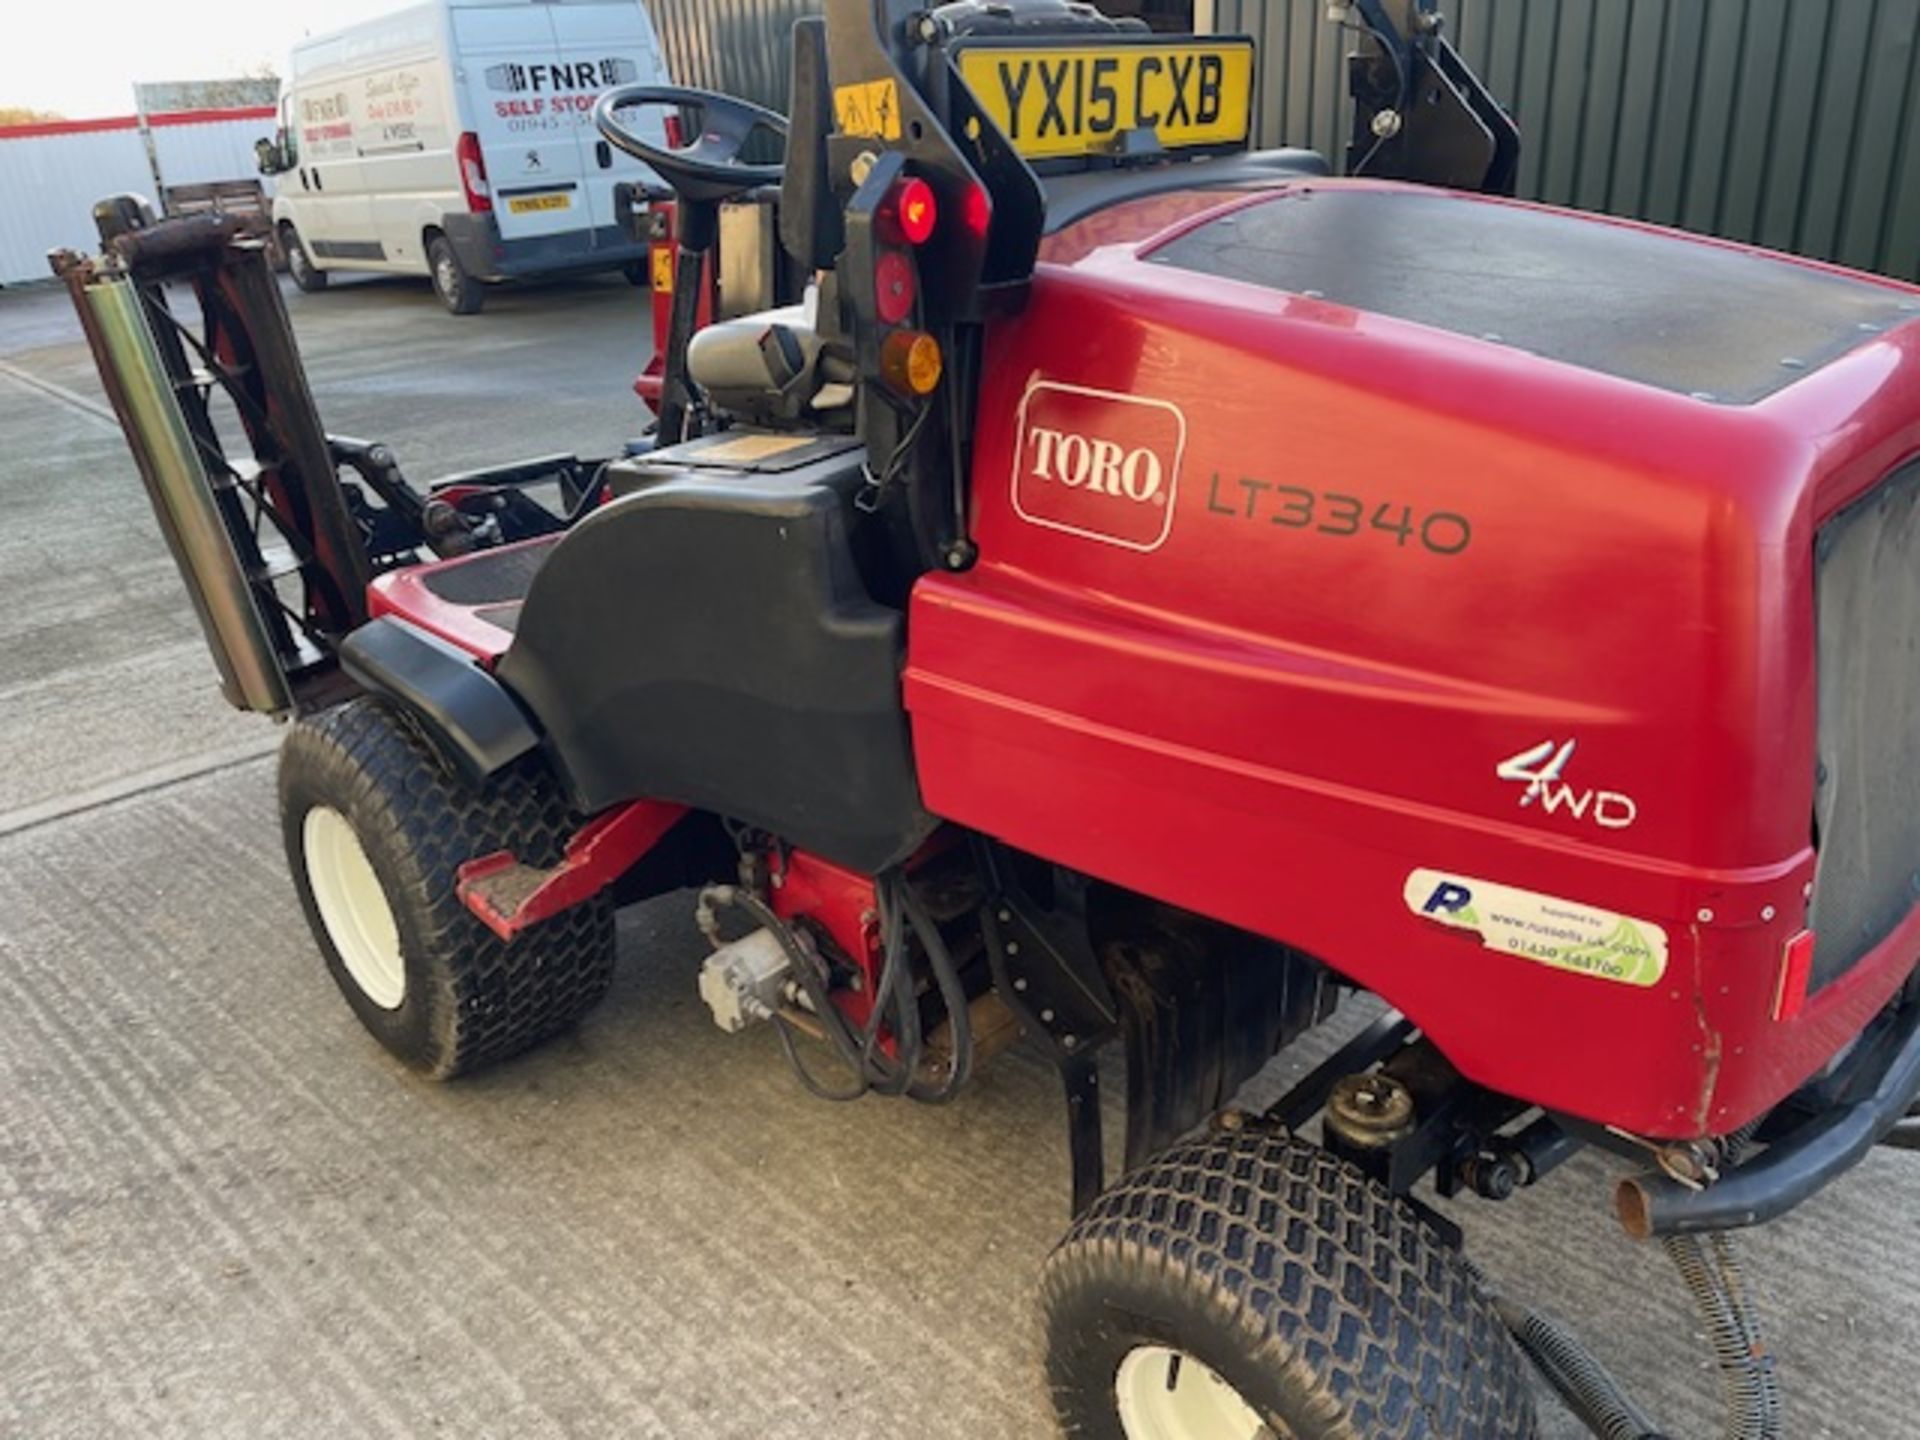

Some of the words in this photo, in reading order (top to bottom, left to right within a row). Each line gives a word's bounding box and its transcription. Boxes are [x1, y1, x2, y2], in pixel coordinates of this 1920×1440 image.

[494, 98, 544, 118] SELF
[528, 62, 599, 92] FNR
[997, 58, 1119, 139] YX15
[1133, 54, 1223, 130] CXB
[1028, 427, 1162, 502] TORO
[1206, 471, 1472, 556] LT3340
[1496, 738, 1637, 828] 4WD
